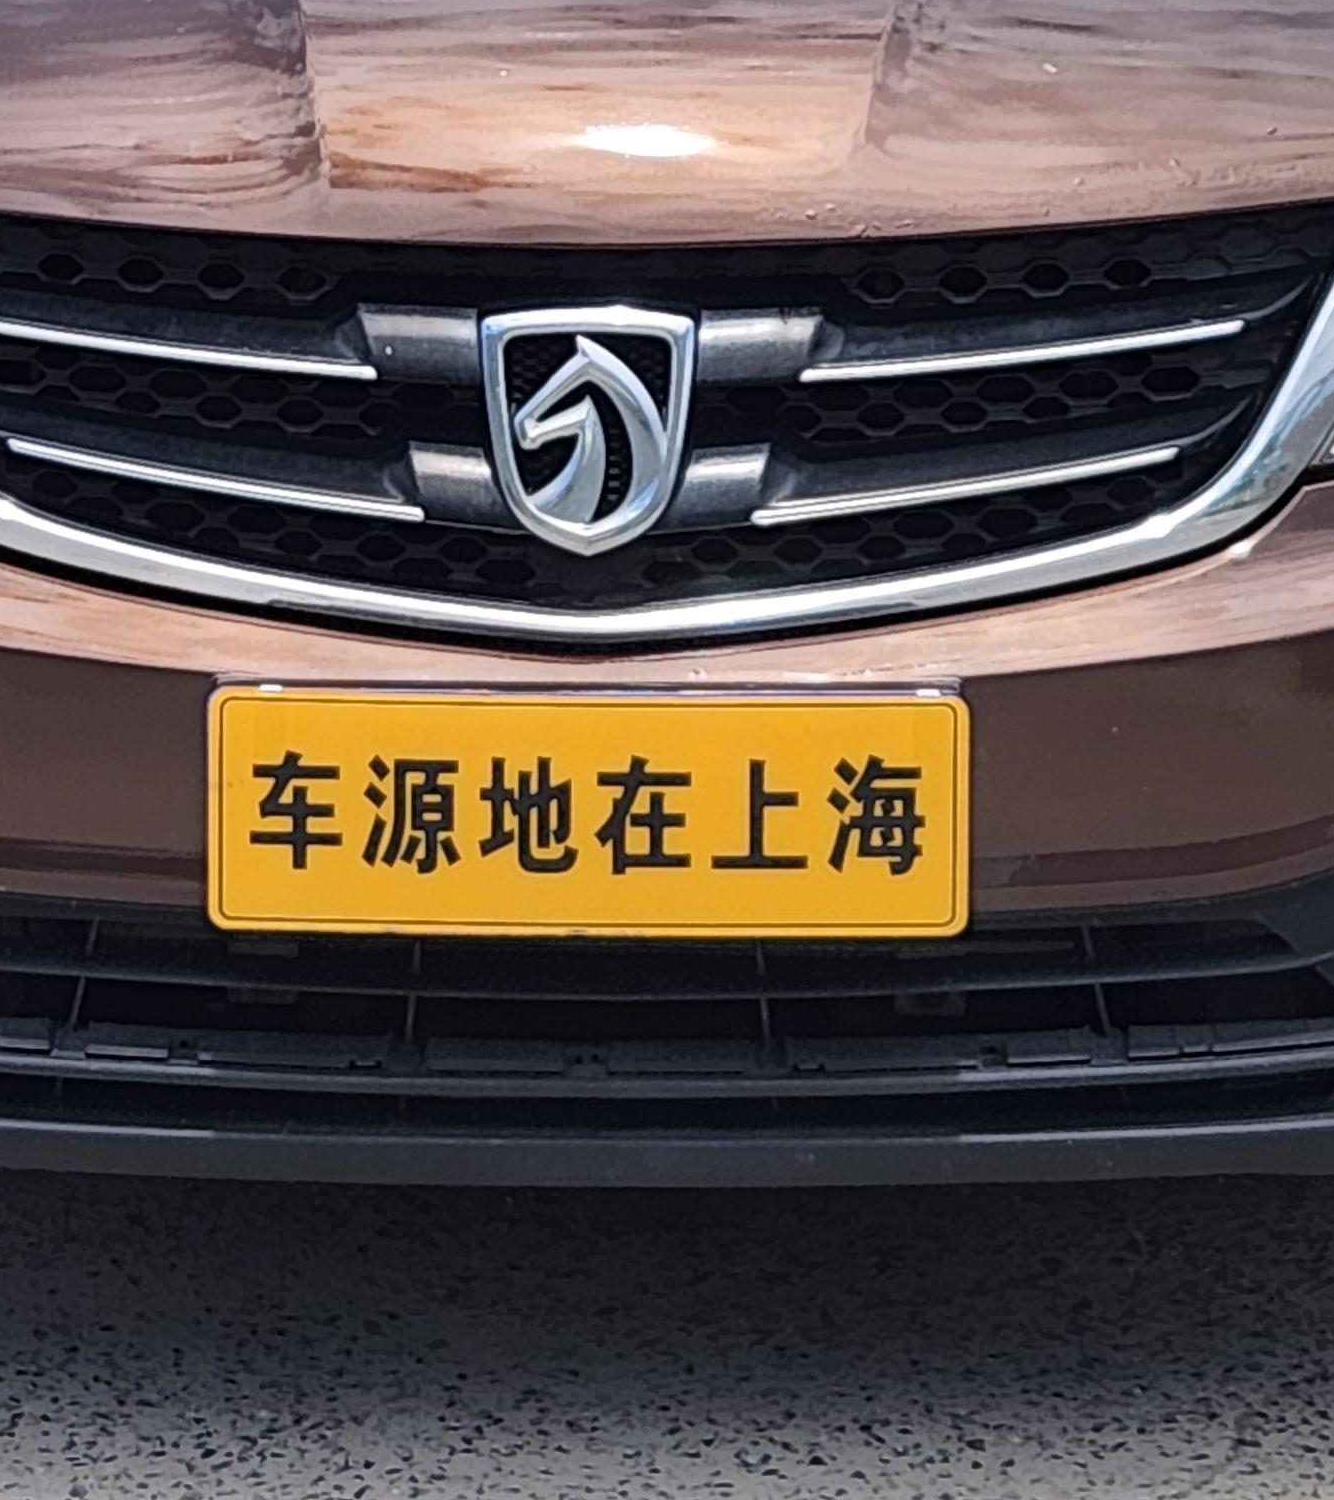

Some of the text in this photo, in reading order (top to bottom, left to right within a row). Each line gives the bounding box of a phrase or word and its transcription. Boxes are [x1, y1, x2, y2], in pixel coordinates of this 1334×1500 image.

[250, 750, 927, 876] 车源地在上海
